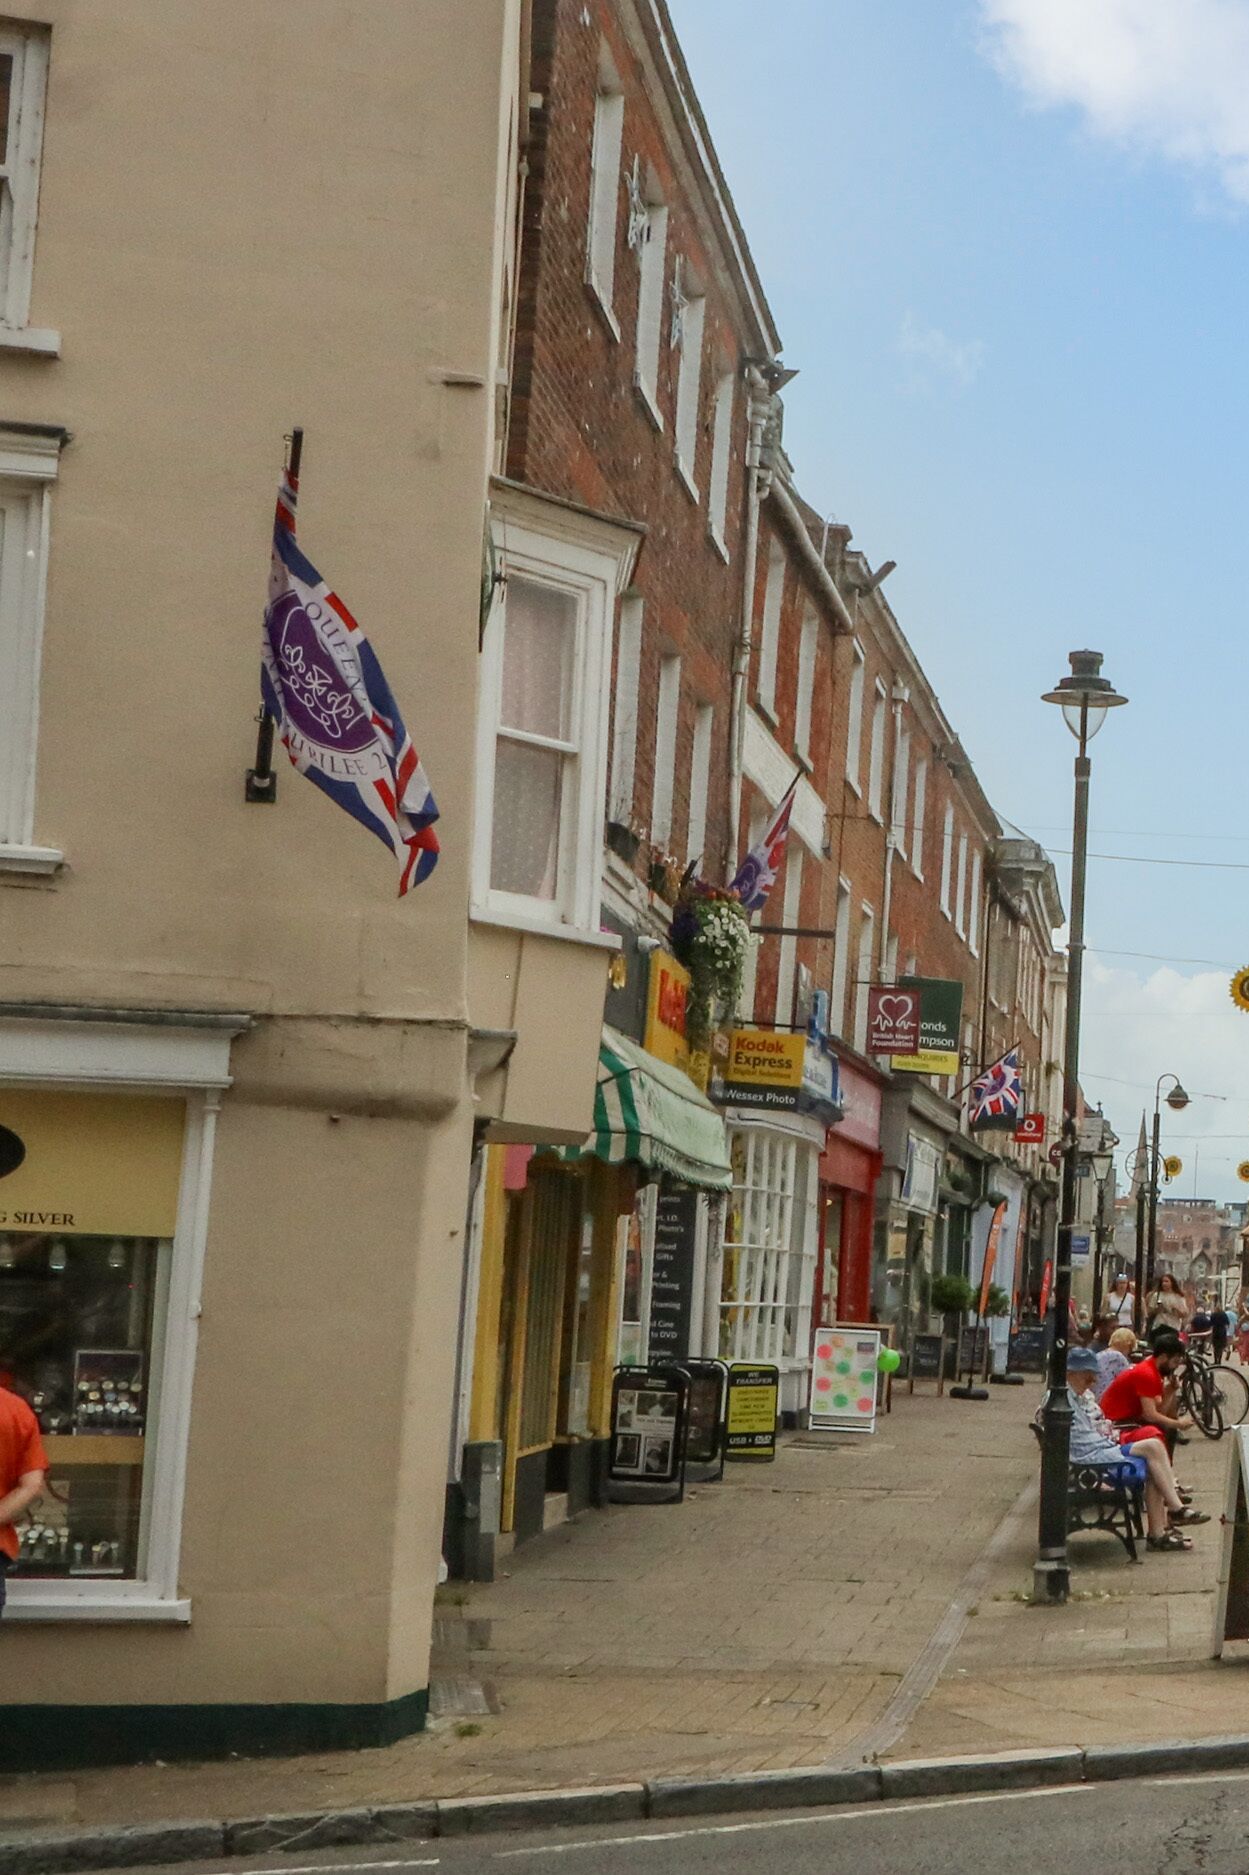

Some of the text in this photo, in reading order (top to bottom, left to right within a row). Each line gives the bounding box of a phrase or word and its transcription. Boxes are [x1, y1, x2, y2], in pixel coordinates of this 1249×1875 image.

[920, 1021, 947, 1033] onds
[872, 1032, 894, 1040] British
[919, 1036, 955, 1048] mpson
[736, 1037, 785, 1054] Kodak
[872, 1039, 914, 1048] Foundation
[734, 1052, 793, 1069] Express
[766, 1092, 796, 1105] Photo
[13, 1210, 76, 1226] SILVER
[660, 1331, 678, 1339] DVD
[729, 1437, 747, 1445] USB
